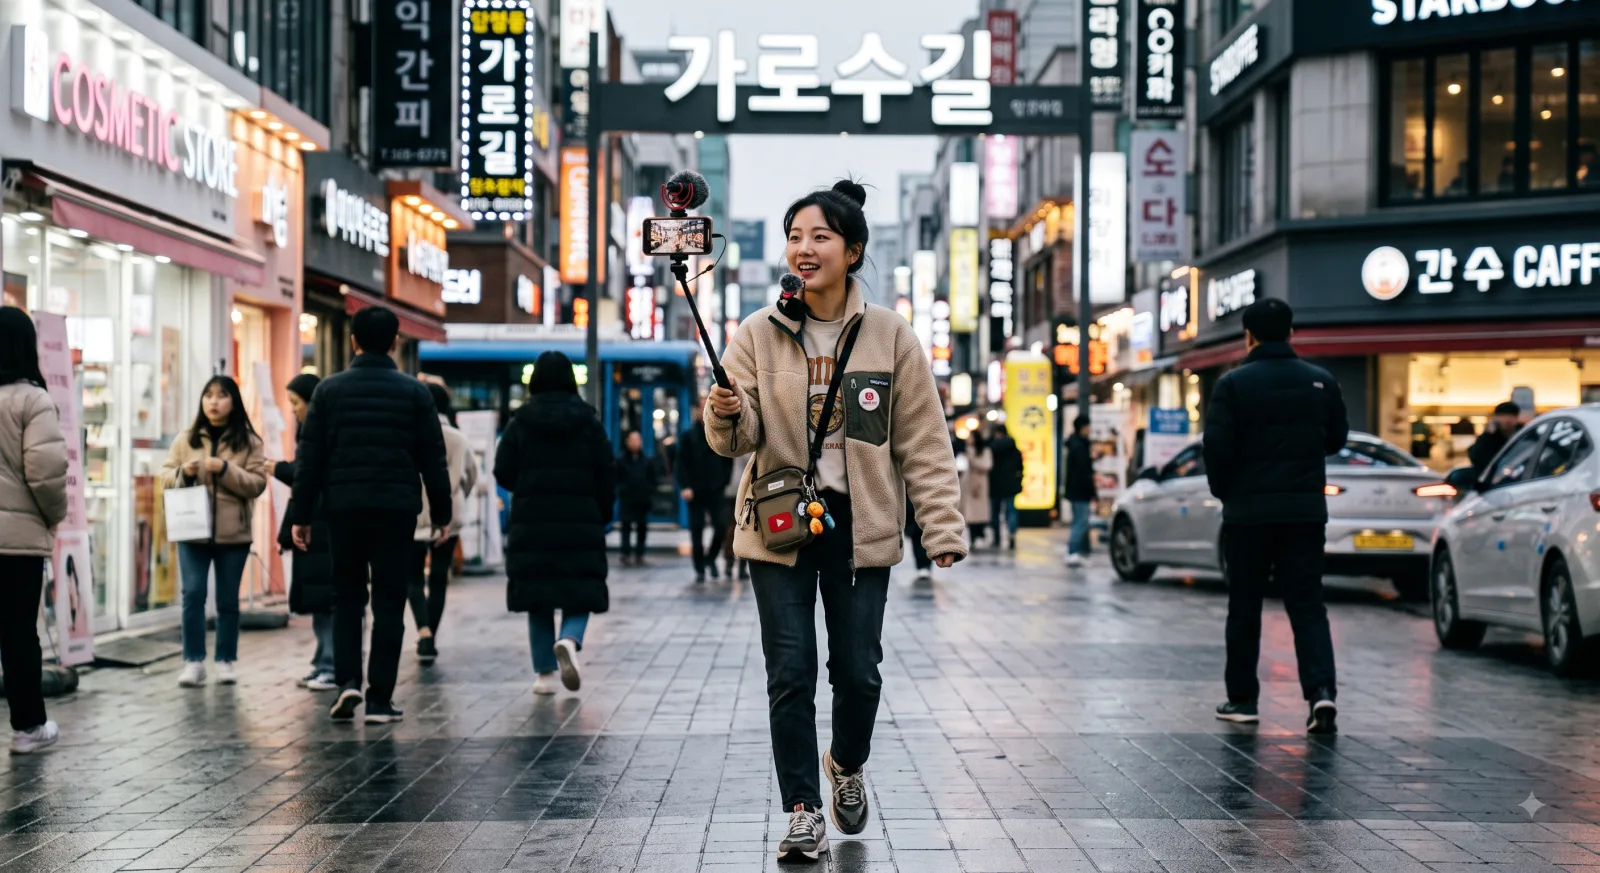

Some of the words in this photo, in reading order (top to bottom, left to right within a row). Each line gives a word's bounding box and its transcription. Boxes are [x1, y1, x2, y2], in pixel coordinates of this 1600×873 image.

[53, 52, 180, 173] COSMETIC
[183, 123, 239, 198] STORE
[477, 37, 521, 175] 가로길
[664, 29, 993, 125] 가로수길
